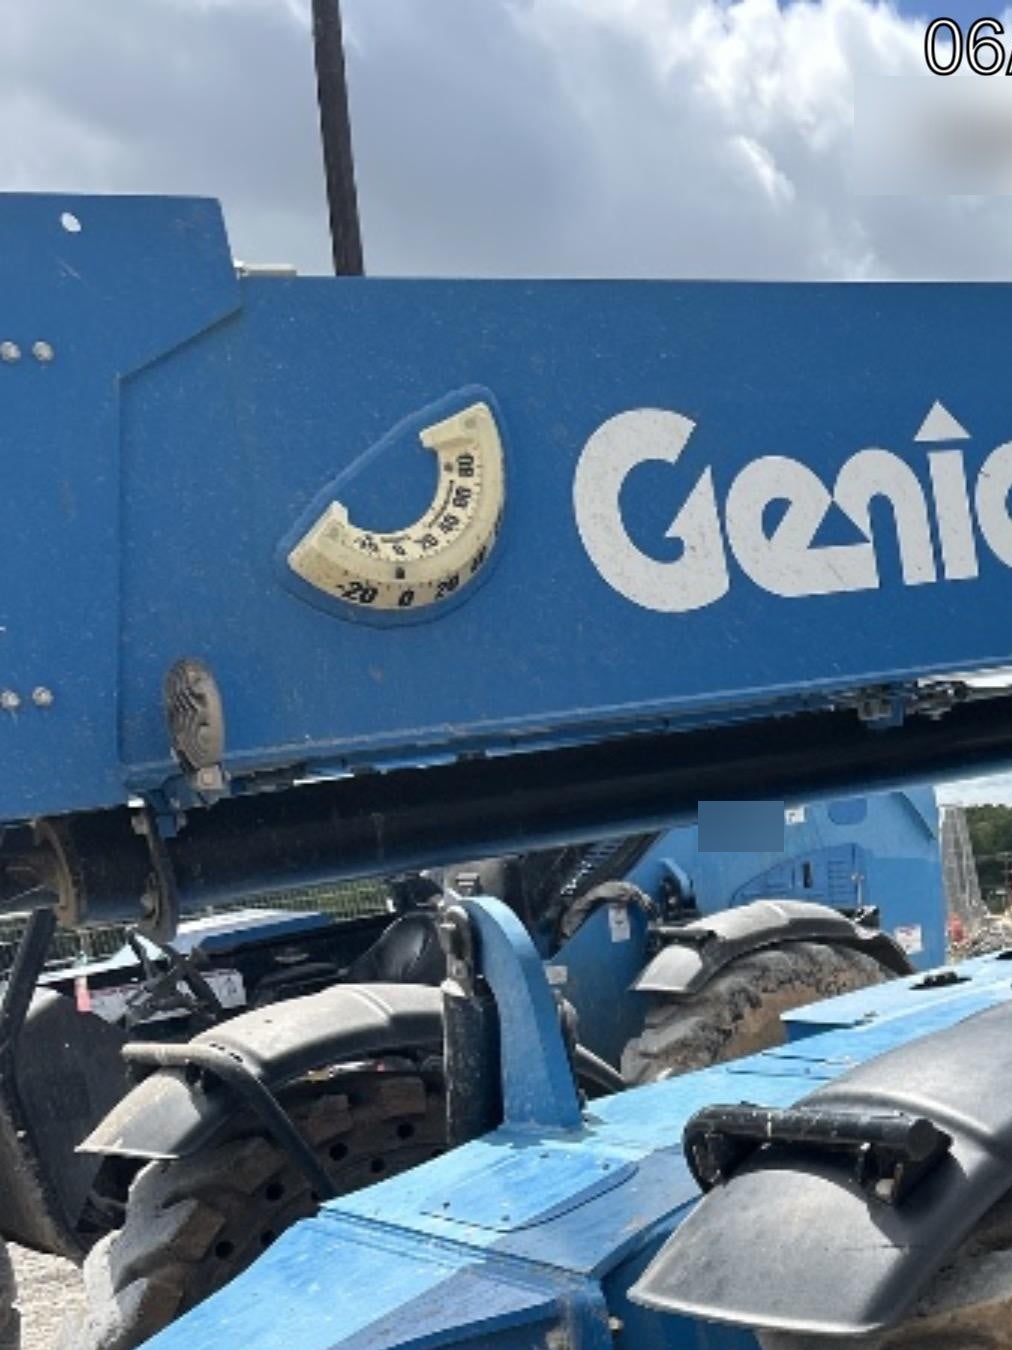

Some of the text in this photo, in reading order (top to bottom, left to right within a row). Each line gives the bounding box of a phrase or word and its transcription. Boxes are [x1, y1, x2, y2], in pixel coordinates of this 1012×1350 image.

[457, 454, 475, 478] 80
[337, 574, 460, 607] -20 0 20
